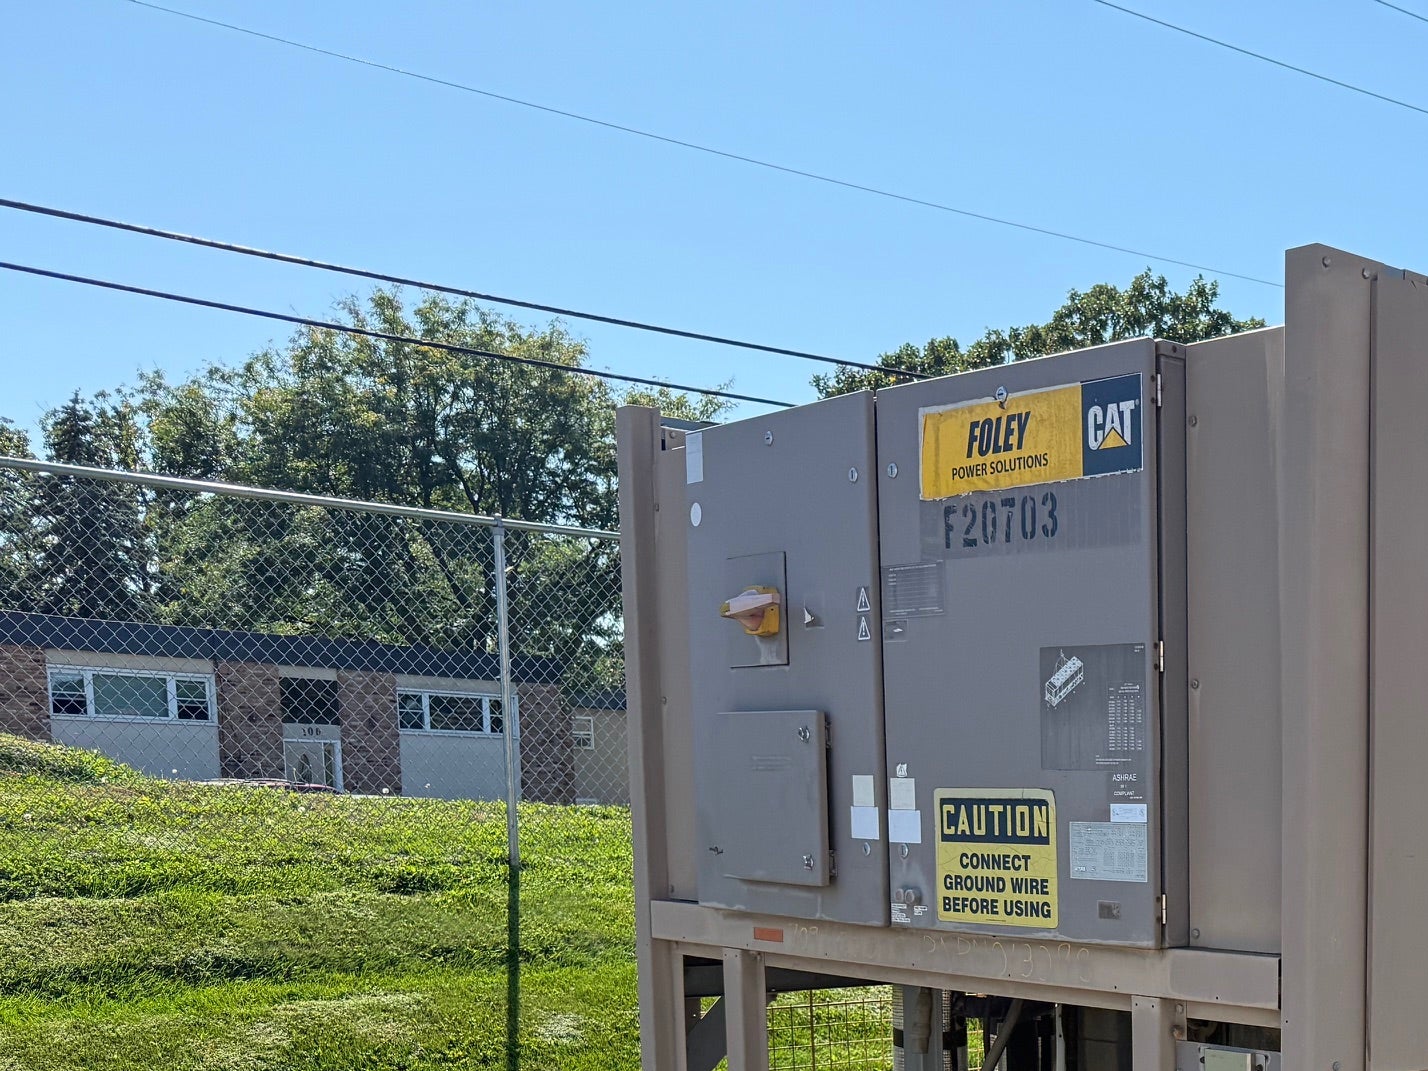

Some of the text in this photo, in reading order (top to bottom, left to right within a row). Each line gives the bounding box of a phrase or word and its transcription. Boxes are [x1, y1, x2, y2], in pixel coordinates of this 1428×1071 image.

[966, 411, 1031, 459] FOLEY
[1087, 399, 1135, 451] CAT
[952, 452, 1049, 480] POWER SOLUTIONS
[943, 492, 1058, 549] F20703
[1112, 773, 1137, 782] ASHRAE
[942, 804, 1048, 837] CAUTION
[959, 852, 1031, 872] CONNECT
[943, 874, 1049, 896] GROUND WIRE
[942, 896, 999, 915] BEFORE
[1003, 899, 1052, 919] USING
